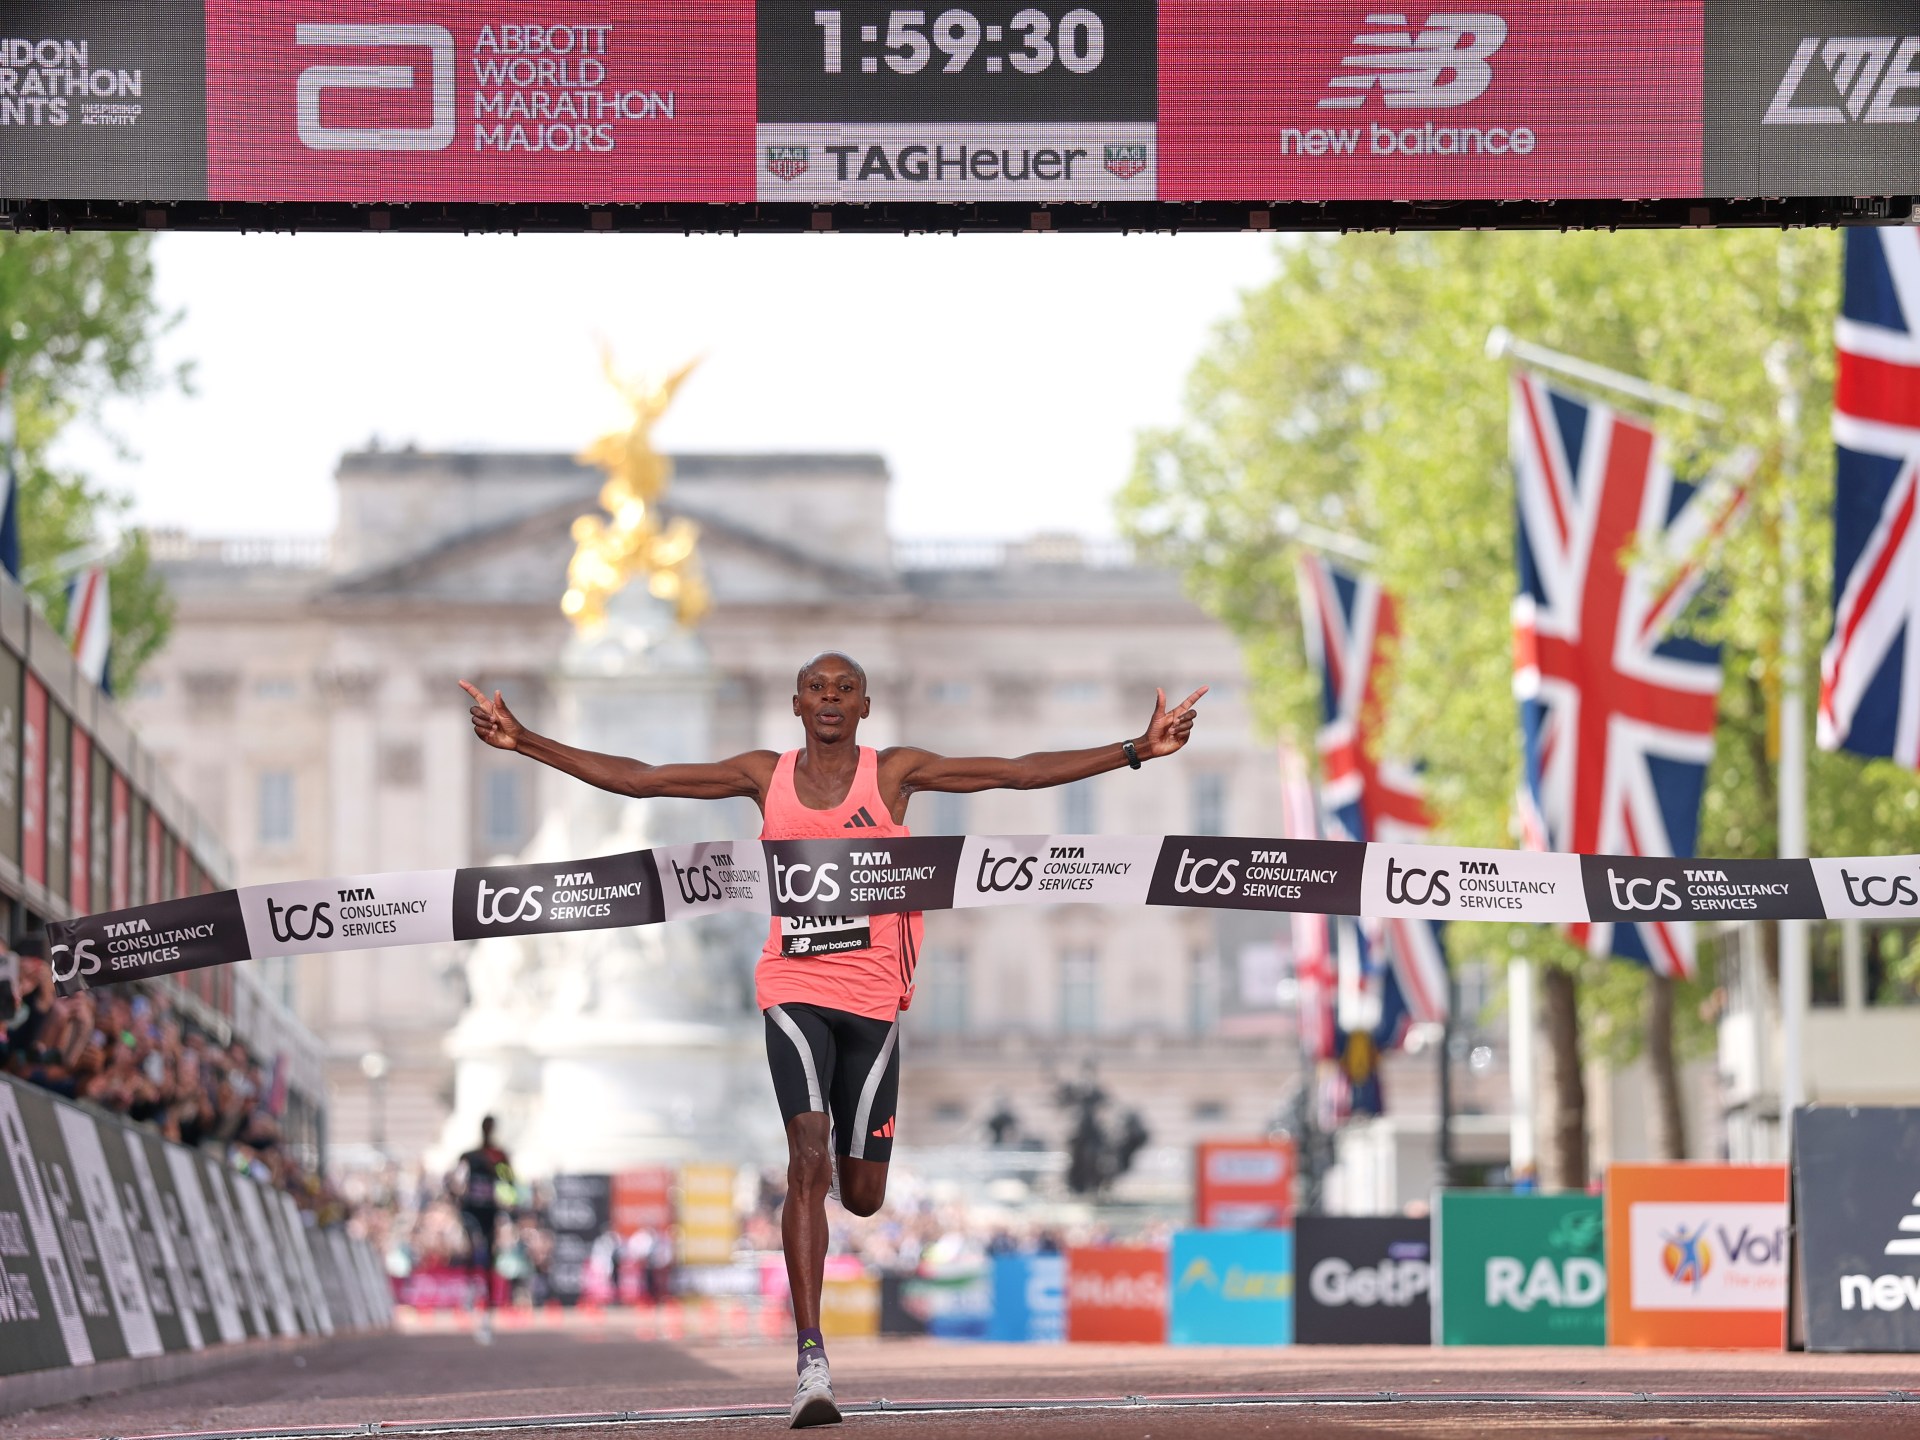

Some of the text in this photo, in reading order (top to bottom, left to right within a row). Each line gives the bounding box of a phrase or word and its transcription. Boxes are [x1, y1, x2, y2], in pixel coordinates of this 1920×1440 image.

[473, 24, 615, 54] ABBOTT
[814, 8, 1104, 74] 1:59:30
[473, 58, 607, 86] WORLD
[0, 68, 141, 96] RATHON
[2, 97, 68, 125] NTS
[474, 91, 676, 119] MARATHON
[82, 115, 137, 125] ACTIVITY
[474, 123, 616, 151] MAJORS
[1281, 121, 1537, 155] new balance
[711, 854, 735, 866] TATA
[850, 851, 892, 866] TATA
[1050, 847, 1085, 858] TATA
[1251, 850, 1288, 864] TATA
[850, 865, 937, 884] CONSULTANCY
[976, 848, 1038, 892] tcs
[1043, 862, 1132, 875] CONSULTANCY
[1174, 848, 1240, 895] tcs
[1245, 866, 1338, 884] CONSULTANCY
[1459, 861, 1499, 875] TATA
[1683, 870, 1729, 882] TATA
[554, 872, 594, 887] TATA
[671, 859, 722, 904] tcs
[773, 854, 841, 904] tcs
[1038, 878, 1094, 891] SERVICES
[1386, 857, 1451, 906] tcs
[1459, 878, 1556, 895] CONSULTANCY
[1840, 868, 1918, 907] tcs
[337, 888, 375, 902] TATA
[552, 881, 642, 903] CONSULTANCY
[725, 887, 753, 899] SERVICES
[850, 885, 906, 902] SERVICES
[1242, 883, 1301, 899] SERVICES
[1607, 868, 1682, 911] tcs
[1687, 883, 1789, 896] CONSULTANCY
[340, 900, 427, 919] CONSULTANCY
[477, 879, 544, 924] tcs
[1460, 895, 1523, 910] SERVICES
[1691, 898, 1758, 910] SERVICES
[267, 898, 334, 942] tcs
[550, 903, 611, 920] SERVICES
[103, 918, 151, 938] TATA
[342, 920, 397, 937] SERVICES
[107, 923, 215, 954] CONSULTANCY
[811, 943, 828, 952] new
[829, 939, 862, 950] balance
[51, 939, 101, 983] cs
[110, 946, 180, 971] SERVICES
[1309, 1257, 1431, 1307] GetP
[1485, 1256, 1607, 1312] RAD
